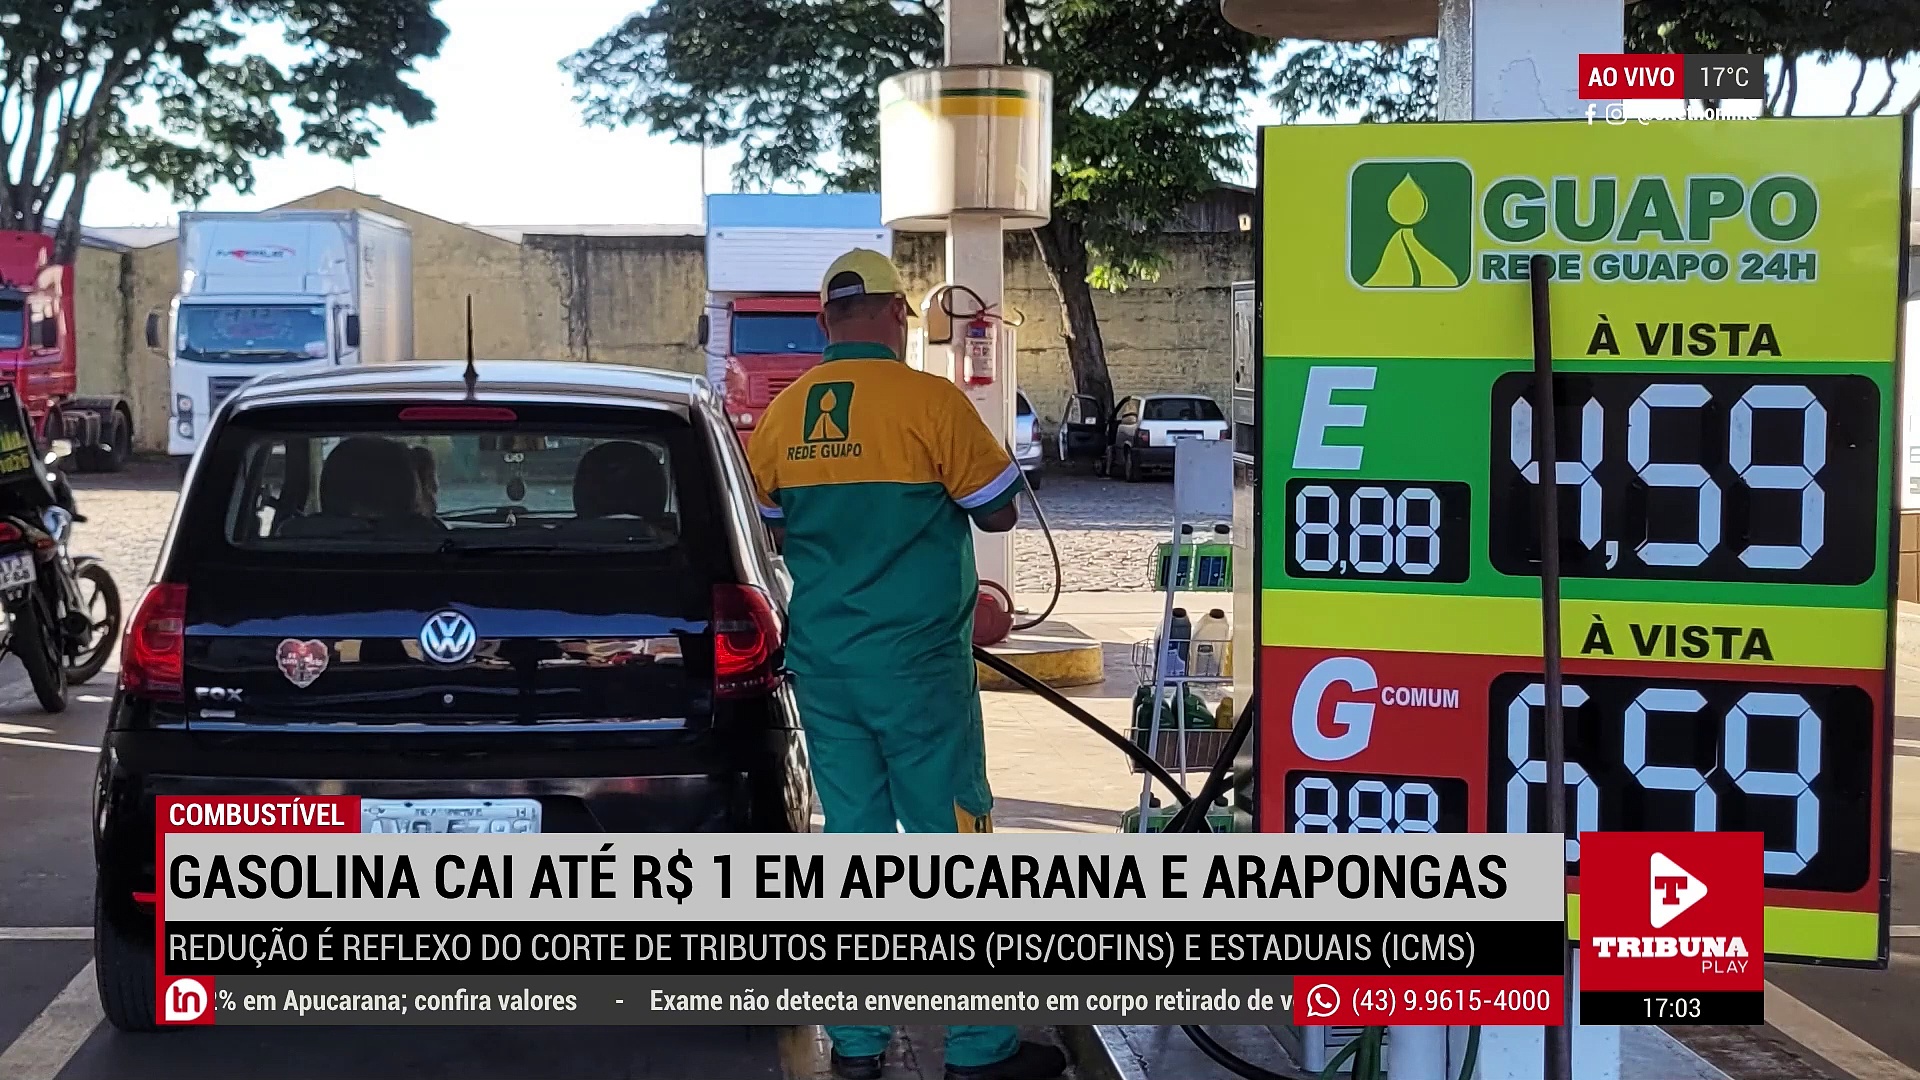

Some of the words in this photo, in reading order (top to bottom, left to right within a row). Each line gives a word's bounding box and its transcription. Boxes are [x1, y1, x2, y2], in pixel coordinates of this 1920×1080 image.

[1483, 176, 1818, 242] GUAPO
[1593, 253, 1729, 281] GUAPO
[1740, 253, 1816, 281] 24H
[1586, 314, 1620, 356] À
[1635, 323, 1783, 357] VISTA
[1292, 366, 1378, 470] E
[787, 444, 817, 461] REDE
[820, 442, 863, 459] GUAPO
[1510, 383, 1828, 570] 4,59
[1295, 485, 1441, 575] 8,88
[1580, 613, 1614, 655] À
[1628, 623, 1775, 661] VISTA
[195, 686, 244, 702] FOX
[1291, 656, 1379, 762] G
[1381, 686, 1460, 708] COMUM
